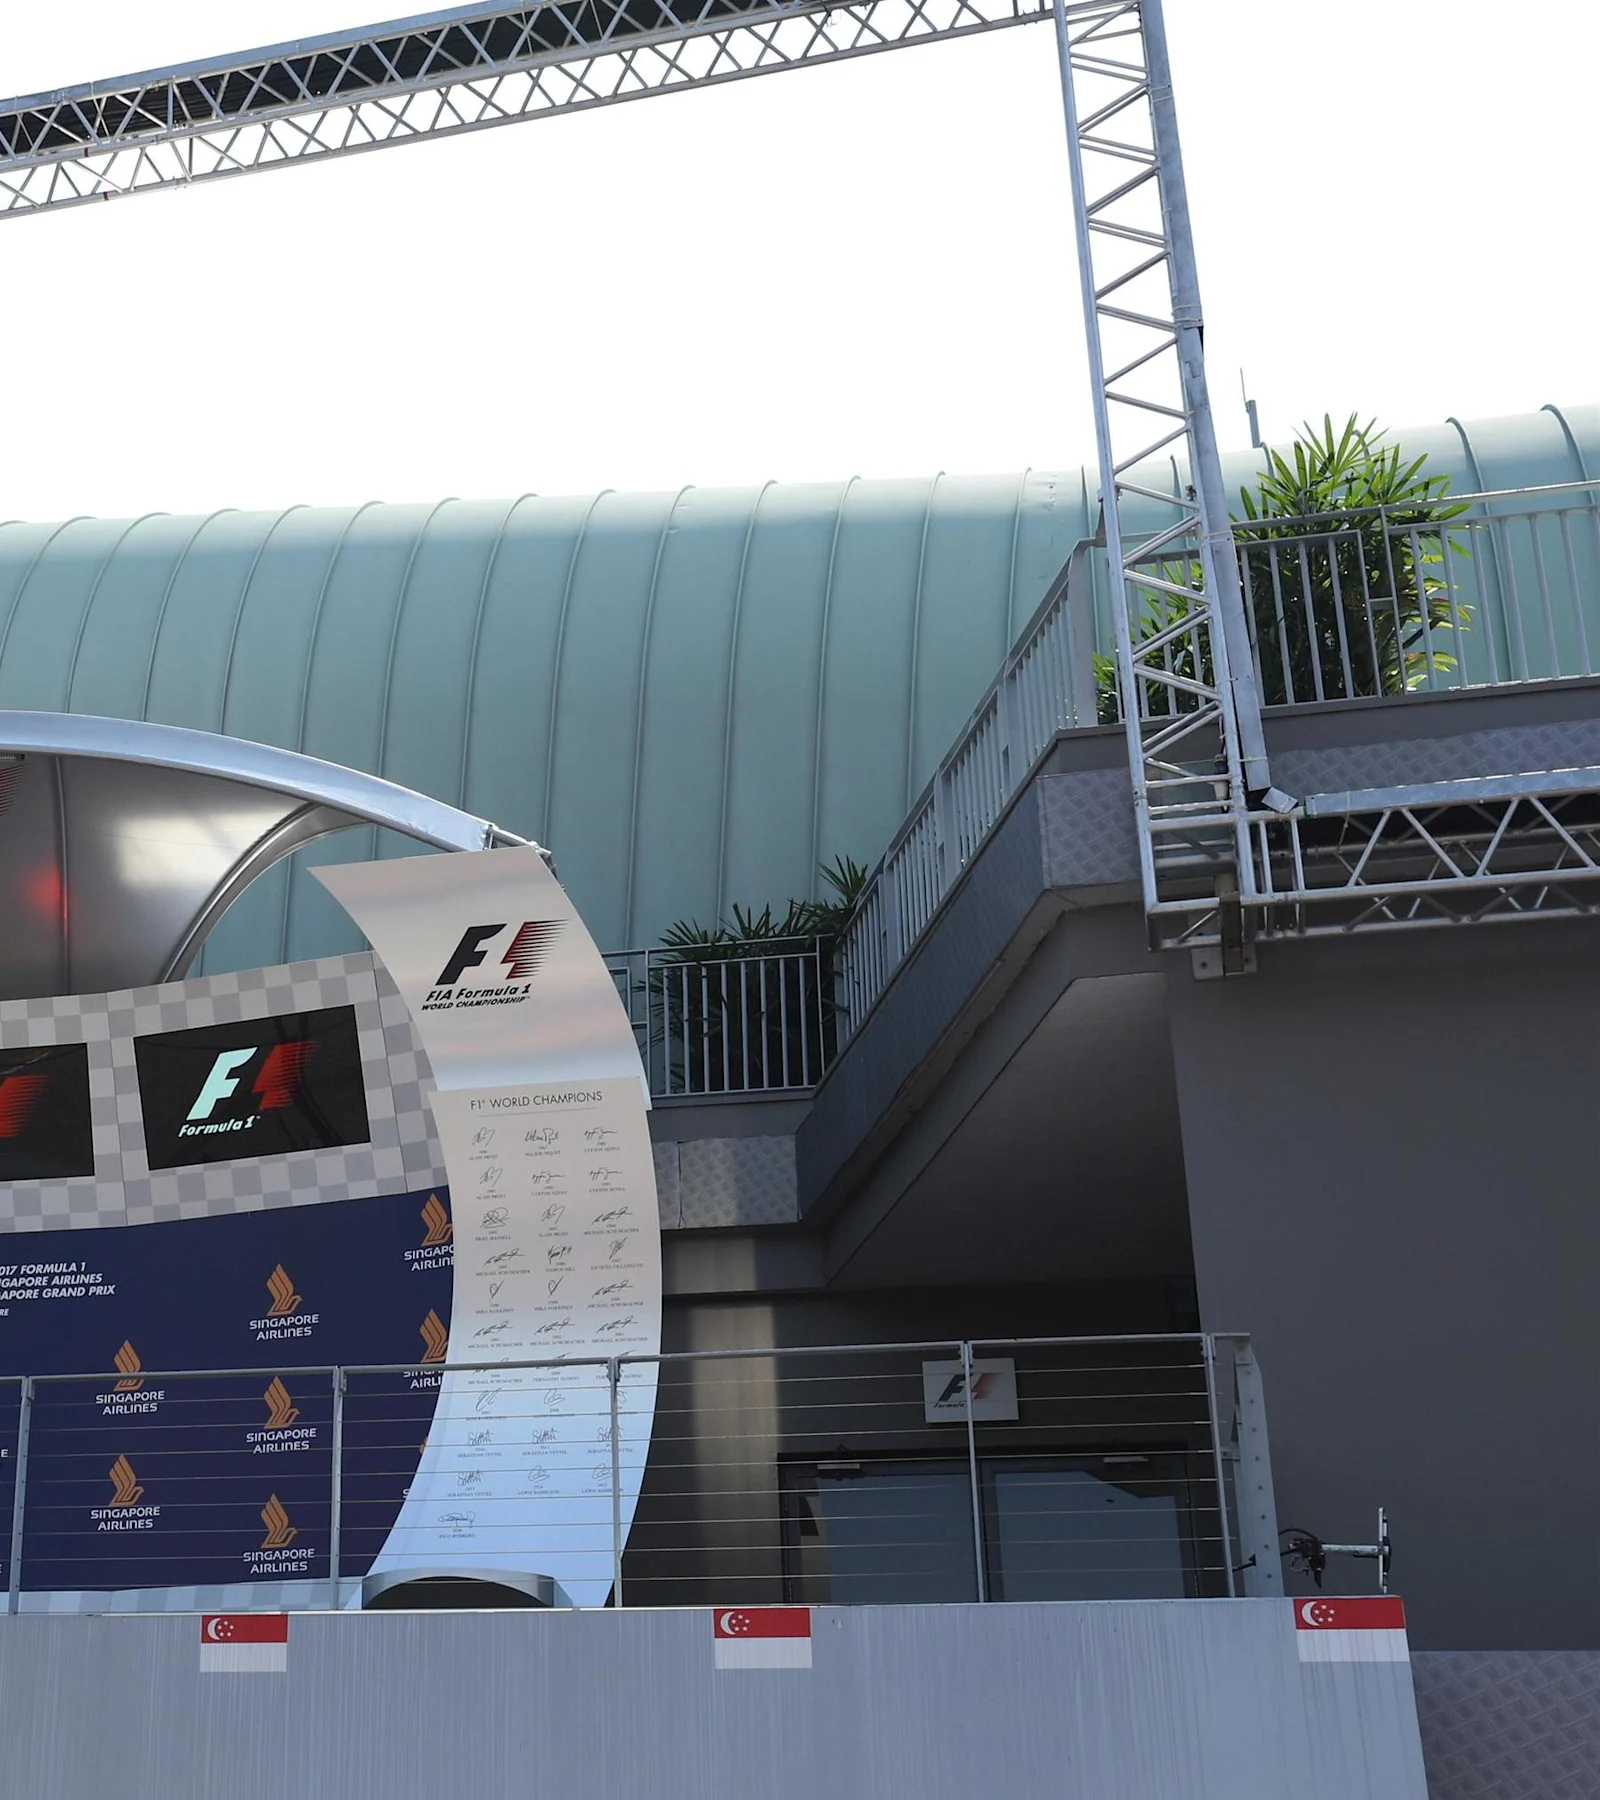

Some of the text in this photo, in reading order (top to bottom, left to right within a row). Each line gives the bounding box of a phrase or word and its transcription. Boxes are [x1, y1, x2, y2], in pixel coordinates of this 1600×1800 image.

[426, 983, 532, 1002] FIA Formula 1
[421, 996, 526, 1011] WORLD CHAMPIONSHIP
[489, 1095, 530, 1109] WORLD
[533, 1091, 603, 1106] CHAMPIONS
[178, 1115, 256, 1138] Formula 1
[404, 1244, 455, 1261] SINGAPO
[20, 1263, 78, 1275] FORMULA
[80, 1262, 86, 1272] 1
[411, 1257, 455, 1272] AIRLINE
[51, 1273, 103, 1285] AIRLINES
[42, 1287, 87, 1298] GRAND
[88, 1285, 116, 1296] PRIX
[249, 1314, 319, 1330] SINGAPORE
[256, 1327, 312, 1341] AIRLINES
[410, 1376, 442, 1390] AIRLI
[95, 1391, 165, 1405] SINGAPORE
[102, 1403, 158, 1415] AIRLINES
[246, 1428, 317, 1443] SINGAPORE
[252, 1440, 310, 1454] AIRLINES
[90, 1506, 160, 1520] SINGAPORE
[97, 1519, 153, 1531] AIRLINES
[243, 1548, 316, 1562] SINGAPORE
[250, 1561, 308, 1574] AIRLINES
